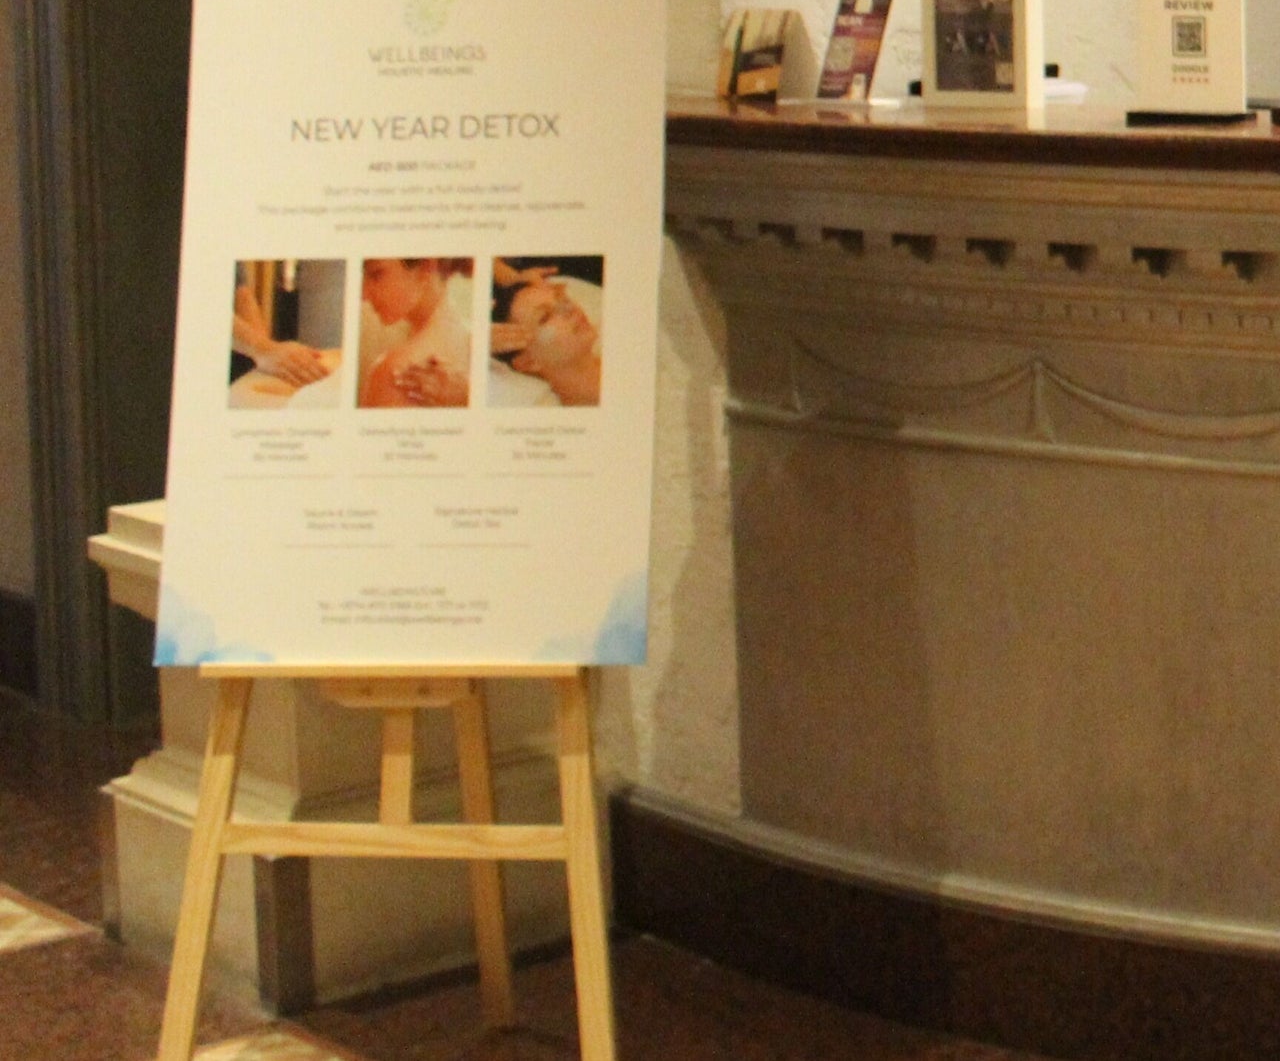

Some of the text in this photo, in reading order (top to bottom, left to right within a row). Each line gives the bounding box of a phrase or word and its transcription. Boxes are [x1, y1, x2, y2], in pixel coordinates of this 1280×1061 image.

[1163, 0, 1215, 11] REVIEW
[368, 44, 487, 63] WELLBEINGS
[290, 112, 561, 142] NEW YEAR DETOX
